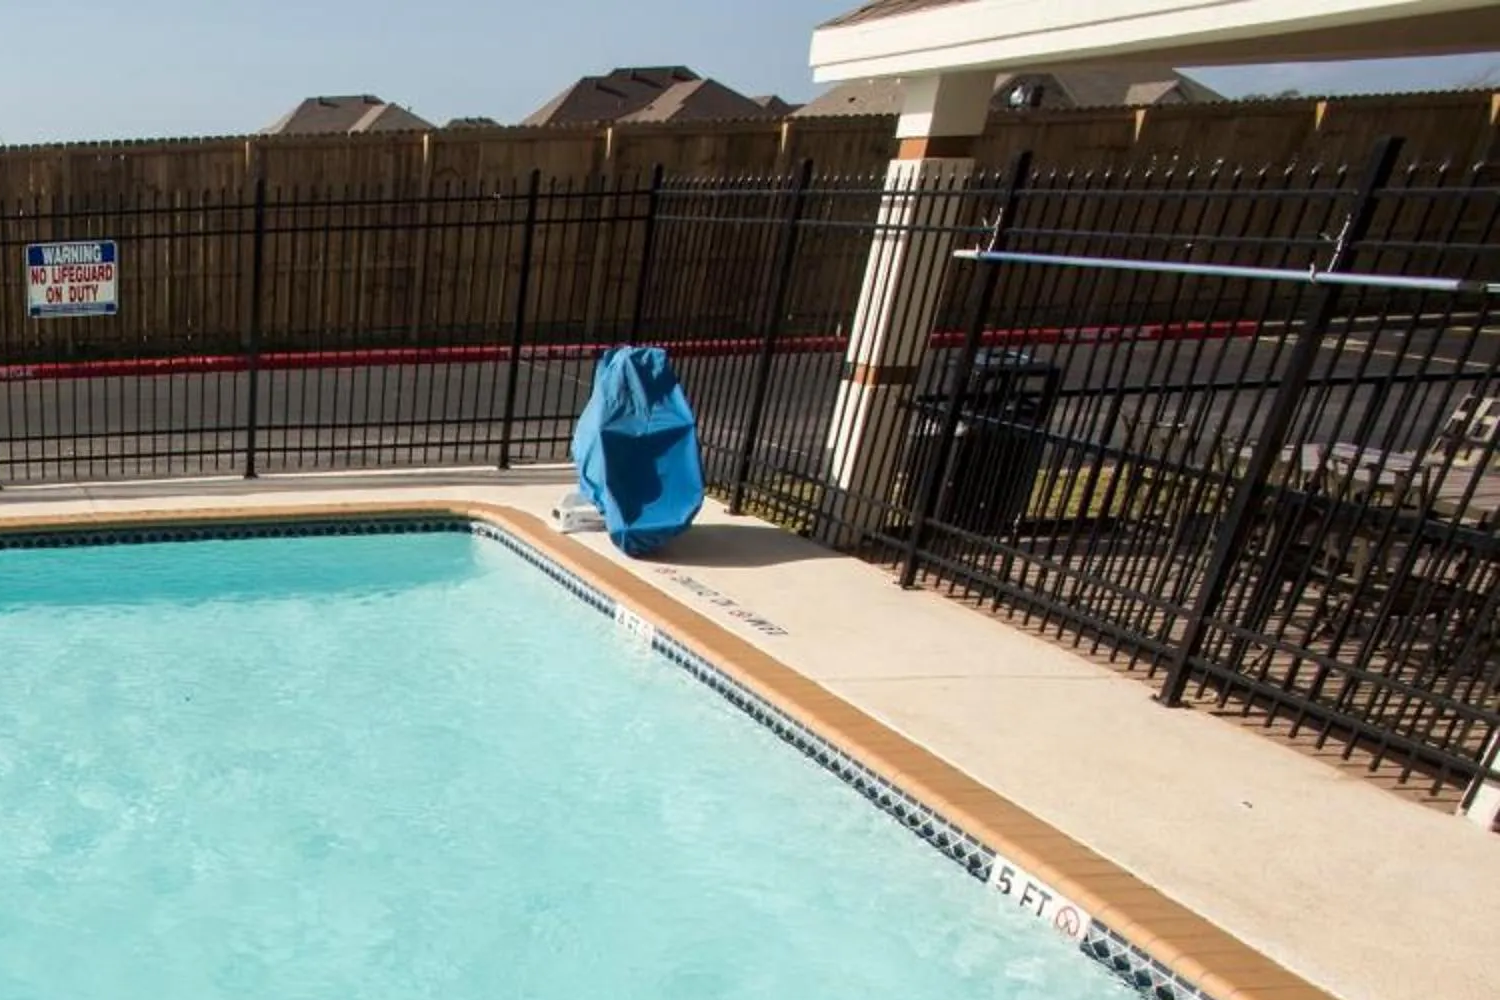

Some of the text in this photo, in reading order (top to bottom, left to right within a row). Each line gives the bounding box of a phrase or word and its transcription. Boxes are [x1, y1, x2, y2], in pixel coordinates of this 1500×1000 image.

[41, 244, 101, 265] WARNING
[31, 264, 113, 285] NO LIFEGUARD
[45, 284, 99, 303] ON DUTY
[996, 866, 1052, 917] 5 FT
